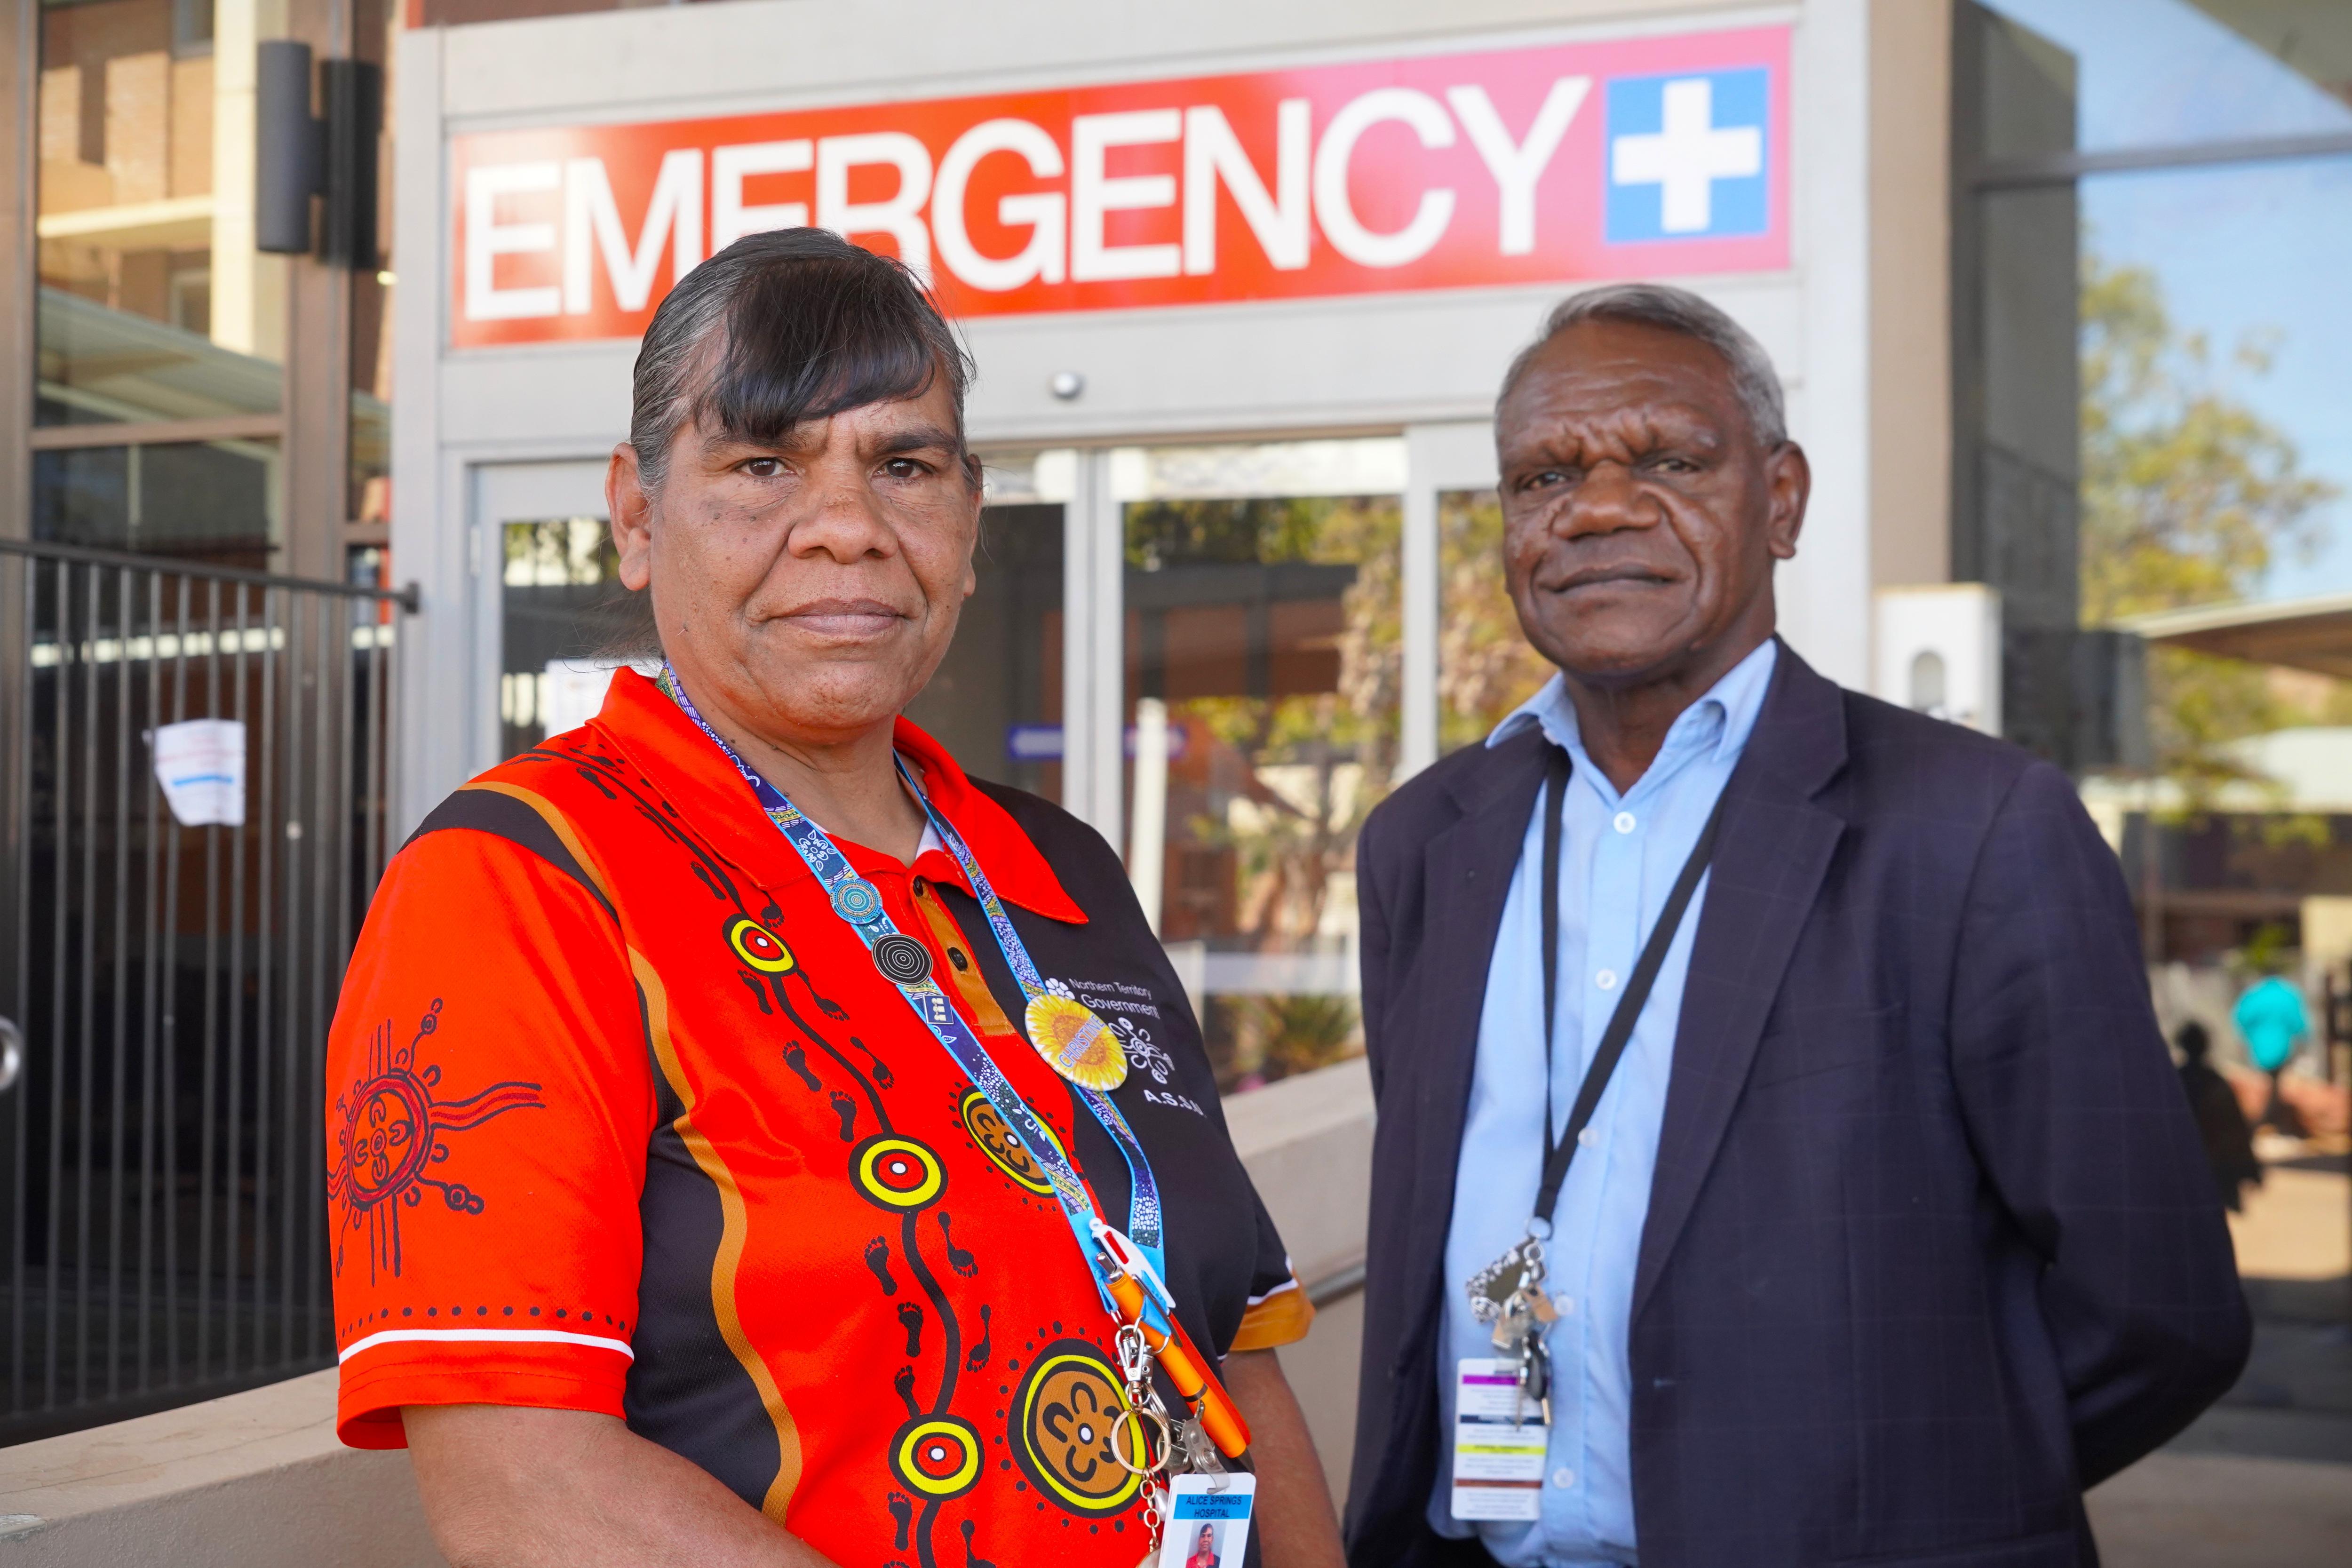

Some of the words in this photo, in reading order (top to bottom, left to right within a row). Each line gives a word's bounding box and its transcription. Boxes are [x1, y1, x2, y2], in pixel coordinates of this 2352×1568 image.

[465, 78, 1589, 320] EMERGENCY
[1069, 978, 1115, 992] Northern
[1113, 982, 1152, 1001] Territory
[1081, 994, 1160, 1019] Government
[1059, 1014, 1105, 1067] CHRISTINE
[1186, 1496, 1208, 1505] ALICE
[1209, 1496, 1242, 1505] SPRINGS
[1194, 1509, 1230, 1518] HOSPITAL
